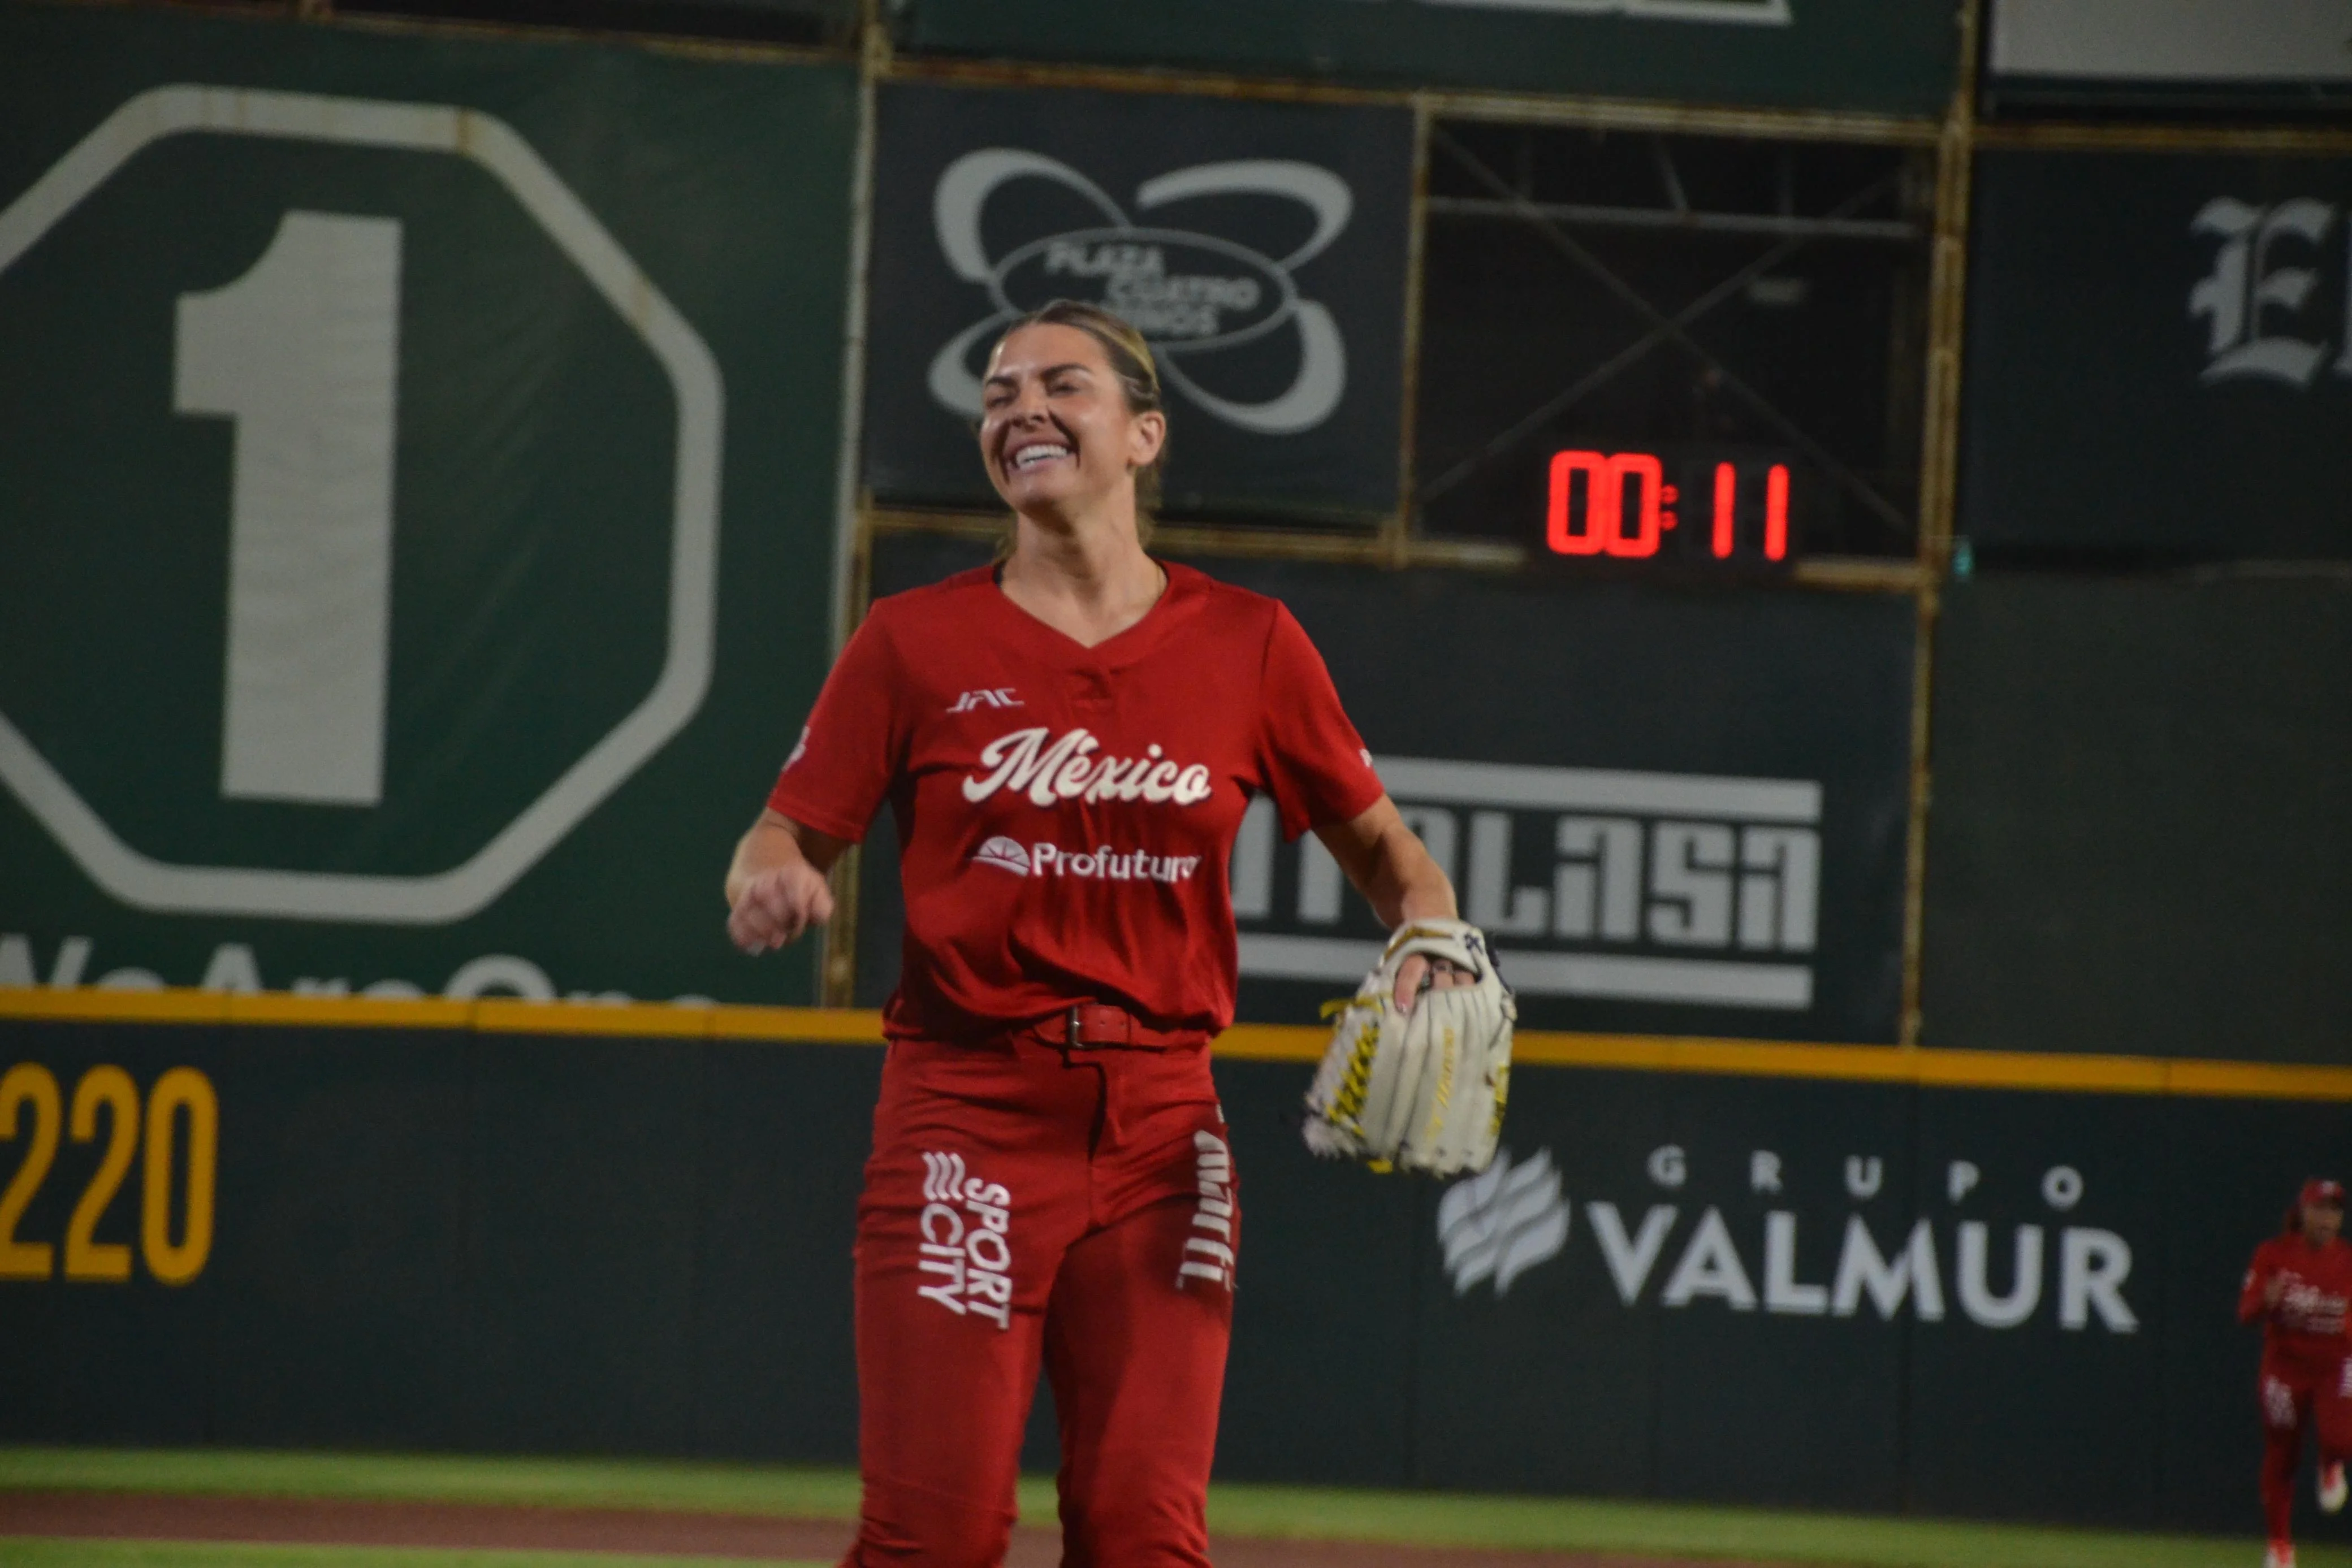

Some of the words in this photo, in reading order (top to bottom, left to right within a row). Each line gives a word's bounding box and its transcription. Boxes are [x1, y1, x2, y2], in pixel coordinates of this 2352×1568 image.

[1044, 240, 1165, 277] PLAZA
[1106, 275, 1262, 311] CUATRO
[173, 209, 403, 807] 1
[1548, 449, 1791, 562] 00:11
[961, 726, 1212, 808] México
[1648, 1144, 2085, 1209] GRUPO
[917, 1203, 966, 1316] CITY
[963, 1177, 1013, 1331] SPORT
[1585, 1201, 2139, 1333] VALMUR
